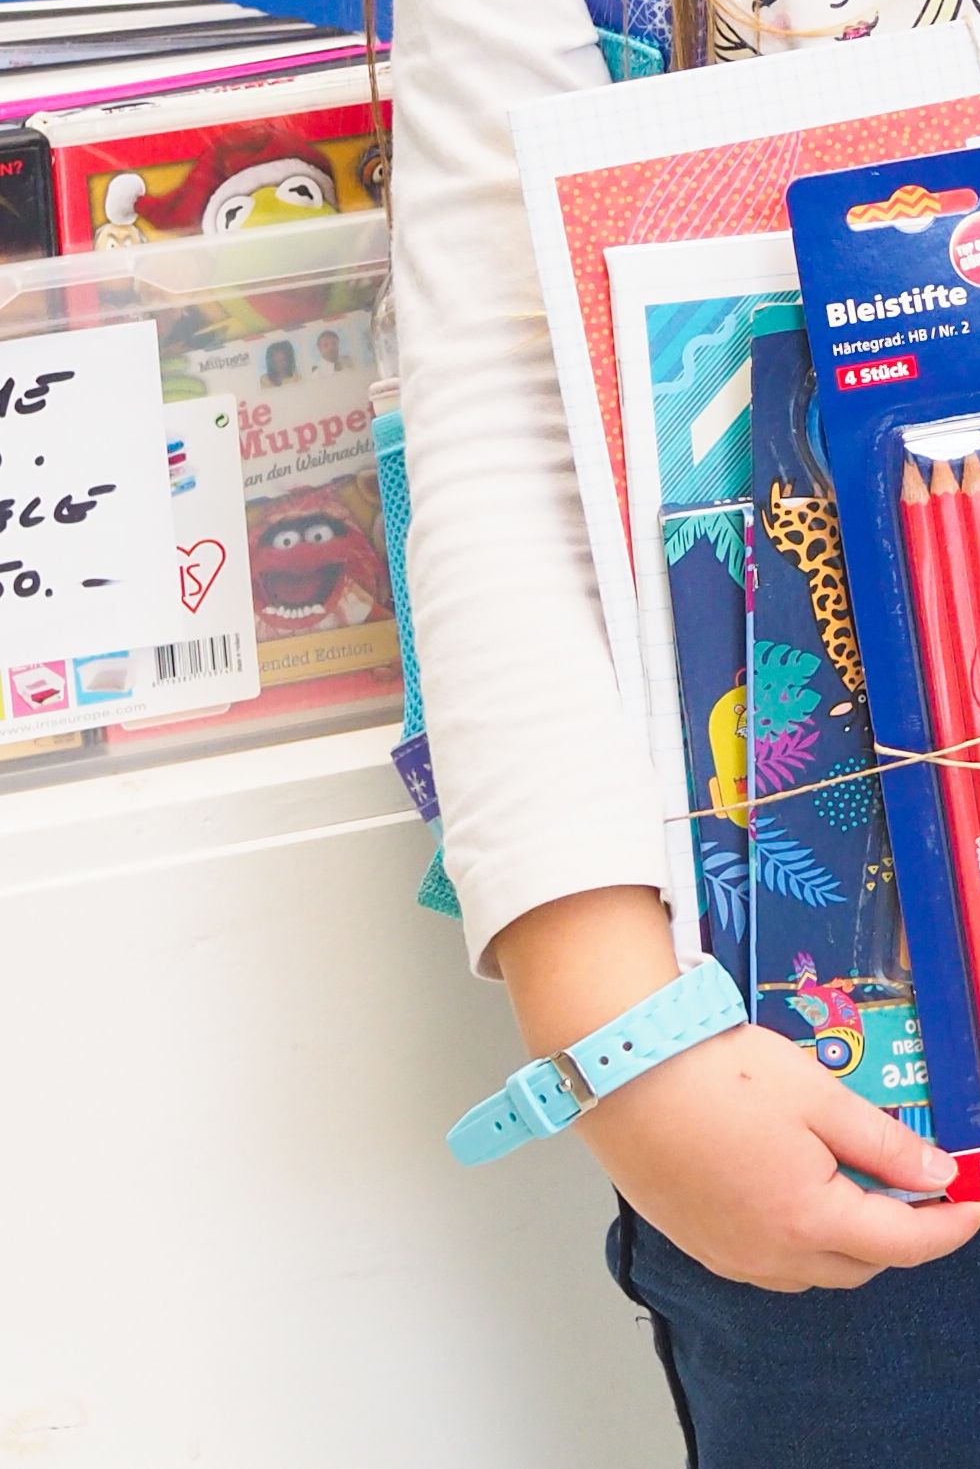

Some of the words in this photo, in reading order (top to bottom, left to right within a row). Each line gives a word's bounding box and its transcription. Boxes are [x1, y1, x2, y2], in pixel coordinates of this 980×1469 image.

[826, 284, 968, 328] Bleistifte
[832, 331, 905, 357] Härtegrad:
[908, 328, 928, 343] HB
[938, 325, 959, 339] Nr.
[961, 321, 970, 335] 2
[843, 370, 858, 387] 4
[860, 361, 910, 384] Stück
[245, 474, 263, 487] an
[267, 464, 292, 482] den
[315, 641, 374, 663] Edition
